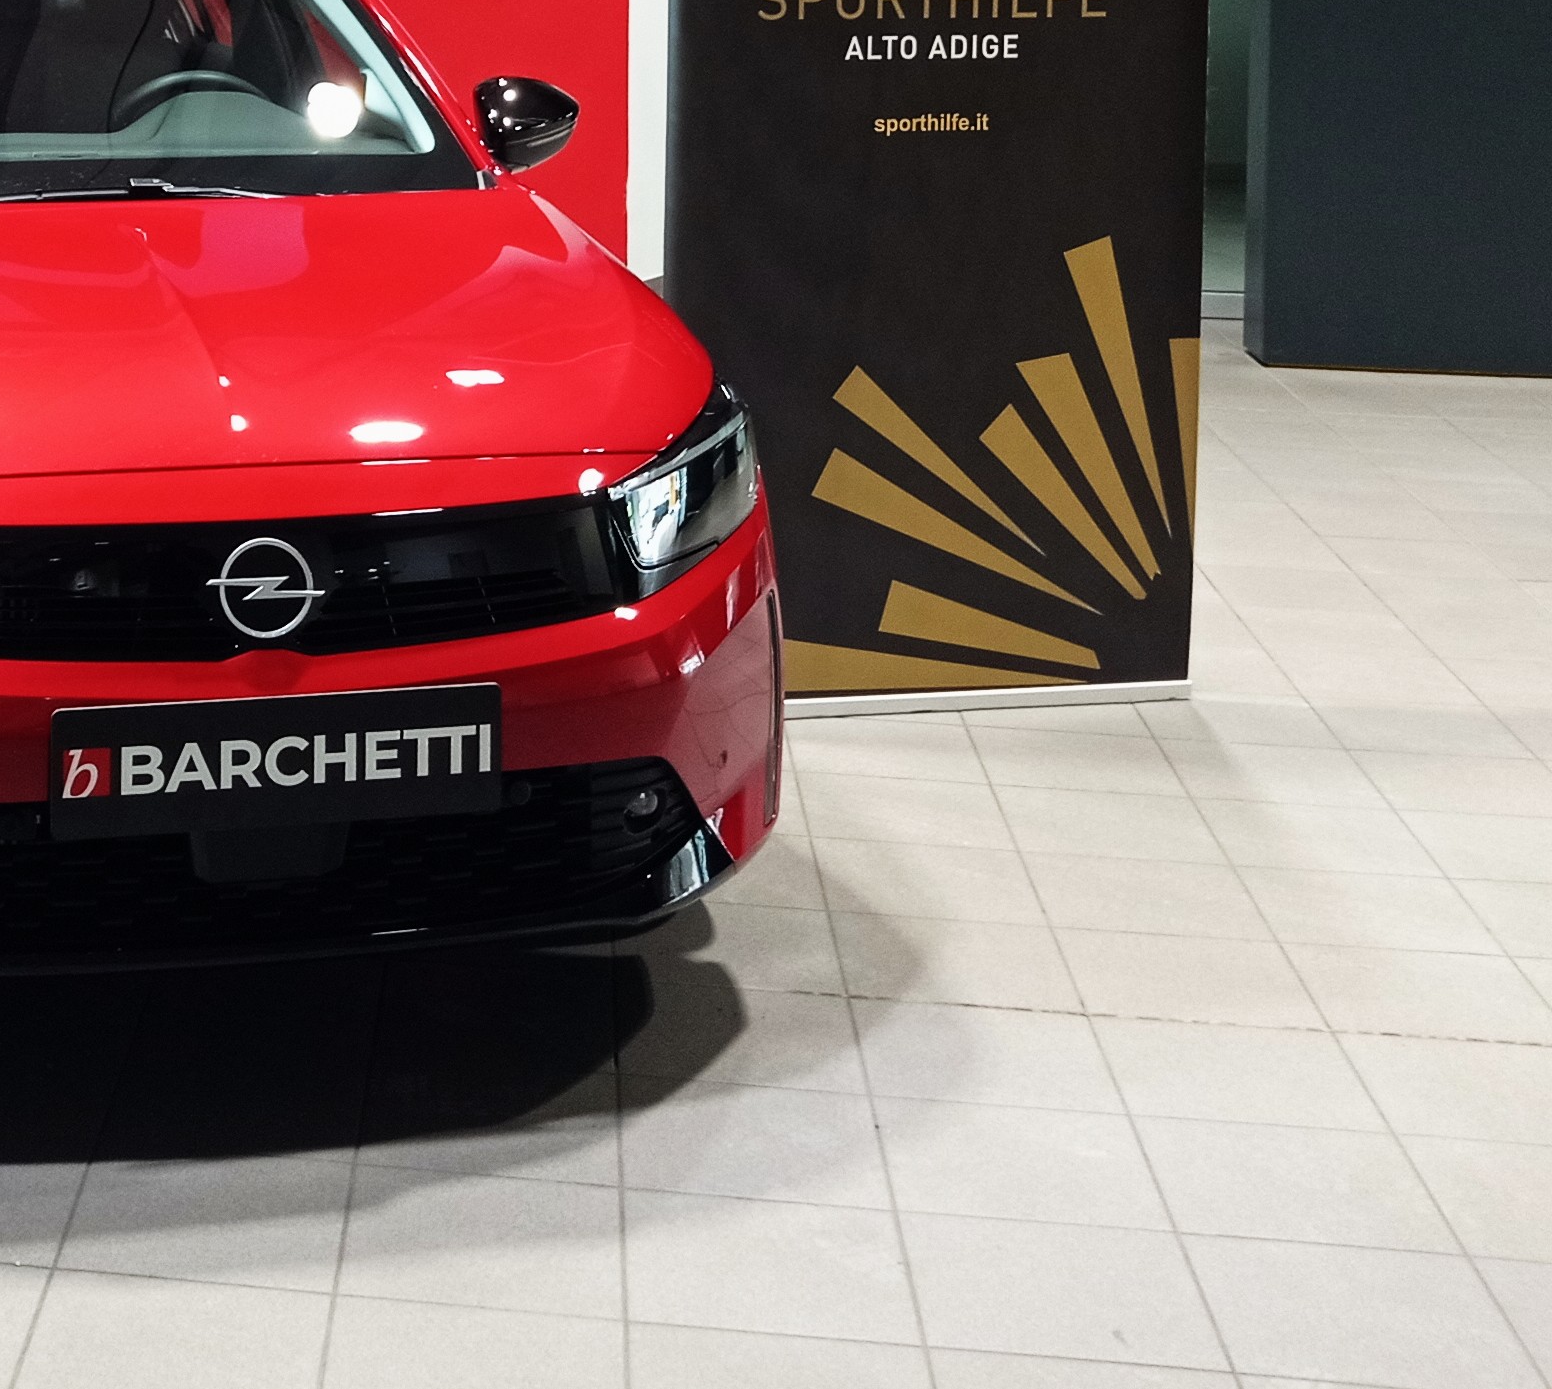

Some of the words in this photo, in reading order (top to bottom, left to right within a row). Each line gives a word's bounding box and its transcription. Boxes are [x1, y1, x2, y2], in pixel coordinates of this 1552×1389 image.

[844, 35, 918, 60] ALTO
[928, 34, 1019, 60] ADIGE
[874, 113, 989, 136] sporthilfe.it
[61, 749, 99, 799] b
[120, 724, 492, 795] BARCHETTI
